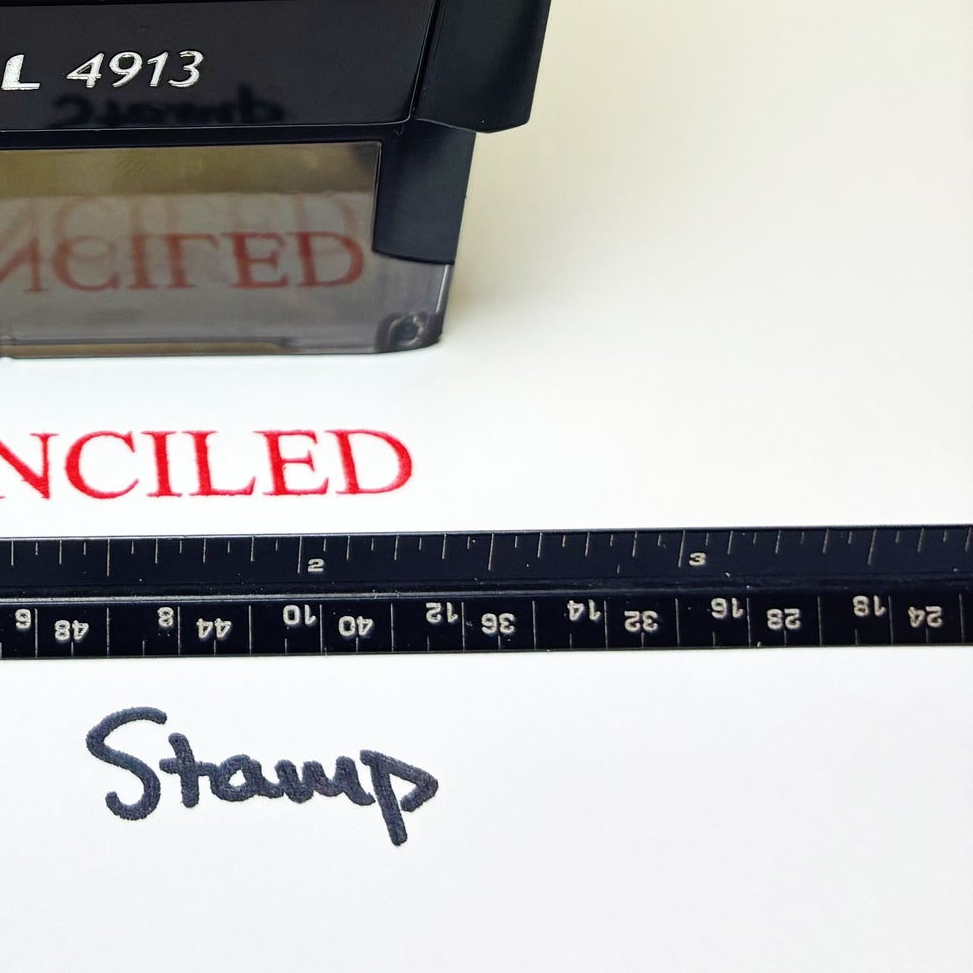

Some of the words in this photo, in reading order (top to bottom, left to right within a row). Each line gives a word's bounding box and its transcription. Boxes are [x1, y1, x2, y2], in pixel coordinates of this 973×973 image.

[67, 51, 203, 88] 4913
[308, 559, 324, 572] 2
[689, 553, 705, 565] 3
[283, 605, 316, 625] 10
[426, 602, 458, 623] 12
[567, 600, 601, 620] 14
[712, 598, 743, 618] 16
[853, 596, 885, 616] 18
[339, 616, 373, 637] 40
[482, 613, 514, 634] 36
[625, 611, 657, 631] 32
[767, 609, 800, 629] 28
[909, 606, 941, 627] 24
[55, 620, 89, 641] 48
[197, 618, 231, 638] 44
[86, 709, 438, 846] Stamp
